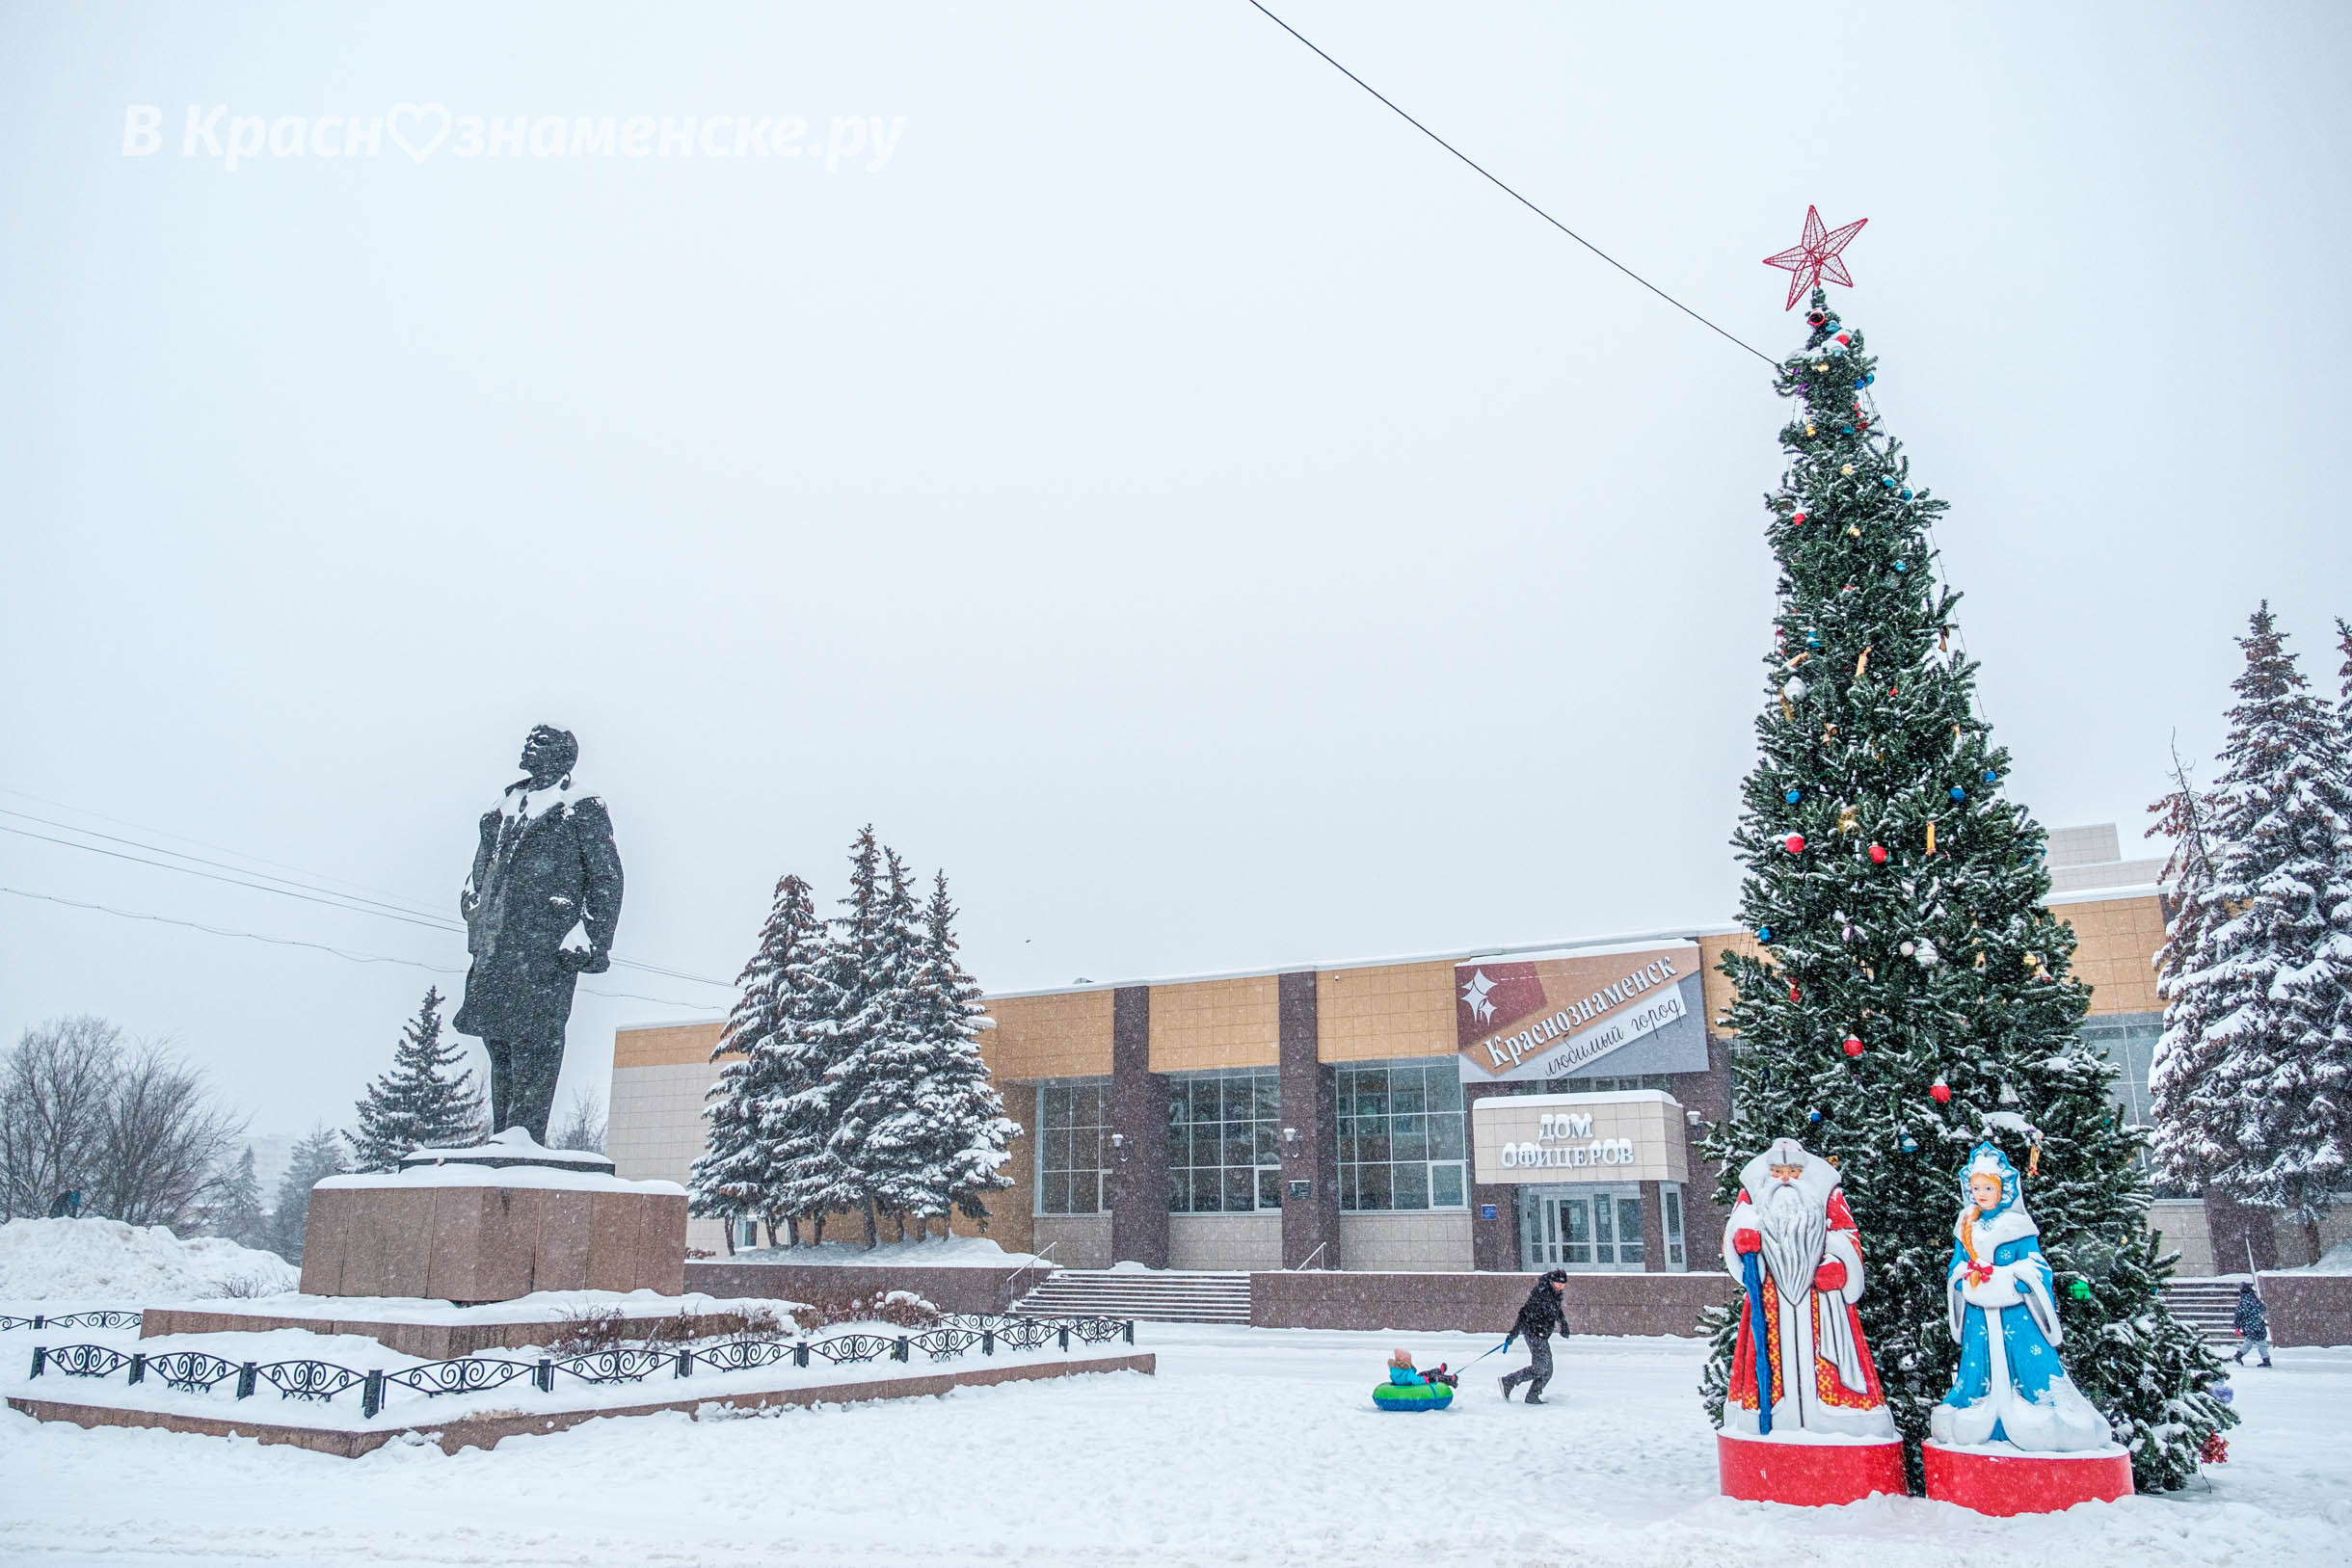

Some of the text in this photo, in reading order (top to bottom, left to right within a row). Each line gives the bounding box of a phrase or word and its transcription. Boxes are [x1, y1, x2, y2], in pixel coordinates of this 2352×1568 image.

[1484, 955, 1678, 1069] Краснознаменск
[1544, 997, 1683, 1077] любимый город
[1501, 1138, 1636, 1170] ОФИЦЕРОВ
[1538, 1112, 1593, 1143] ДОМ
